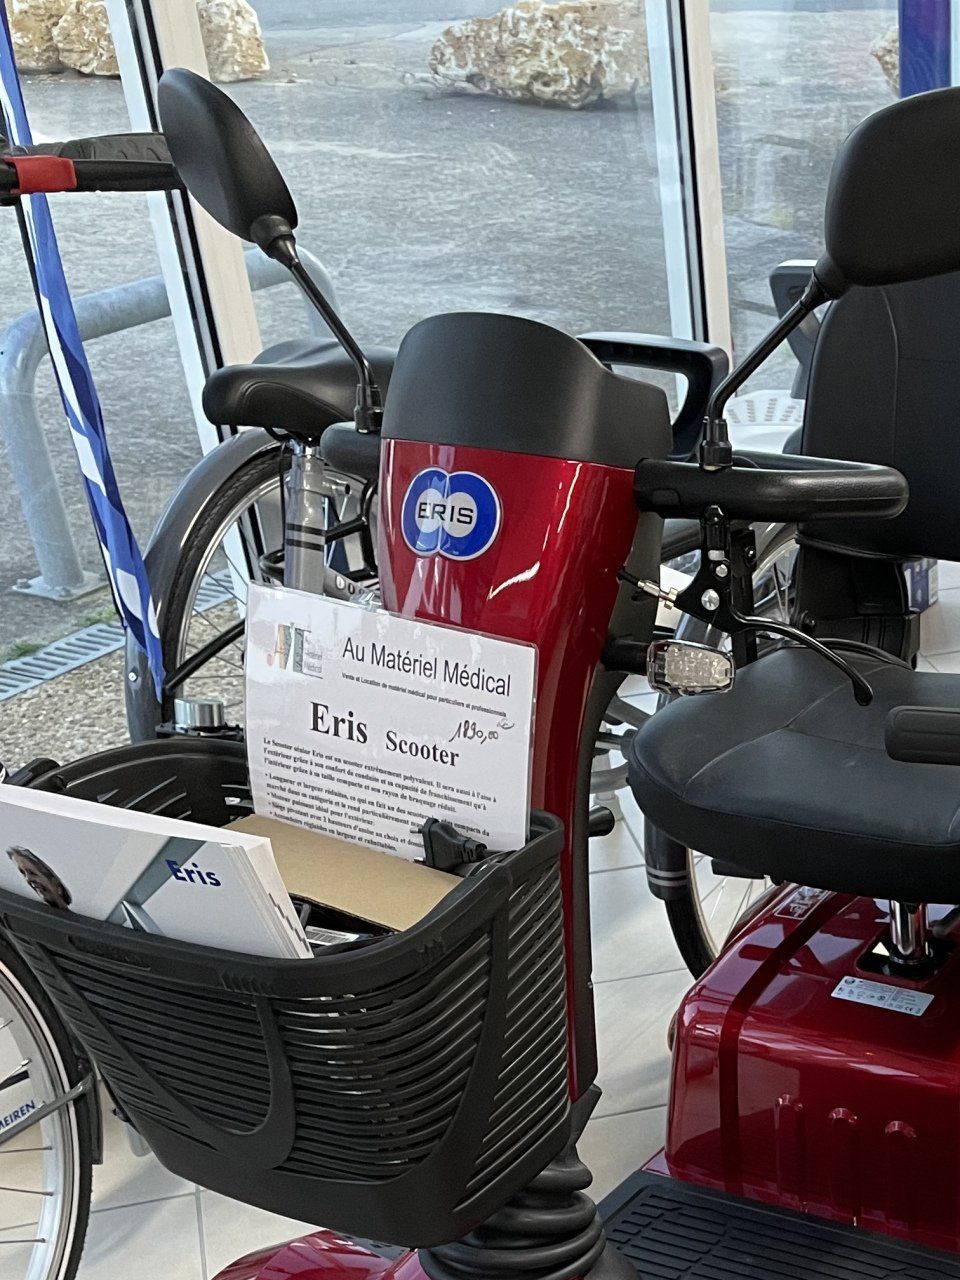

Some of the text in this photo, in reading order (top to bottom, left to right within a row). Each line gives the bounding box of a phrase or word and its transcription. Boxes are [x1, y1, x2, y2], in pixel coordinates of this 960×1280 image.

[418, 502, 473, 524] ERIS
[342, 637, 364, 662] Au
[371, 642, 437, 679] Matériel
[444, 659, 511, 696] Médical
[310, 701, 459, 767] Eris Scooter
[165, 859, 221, 887] Eris
